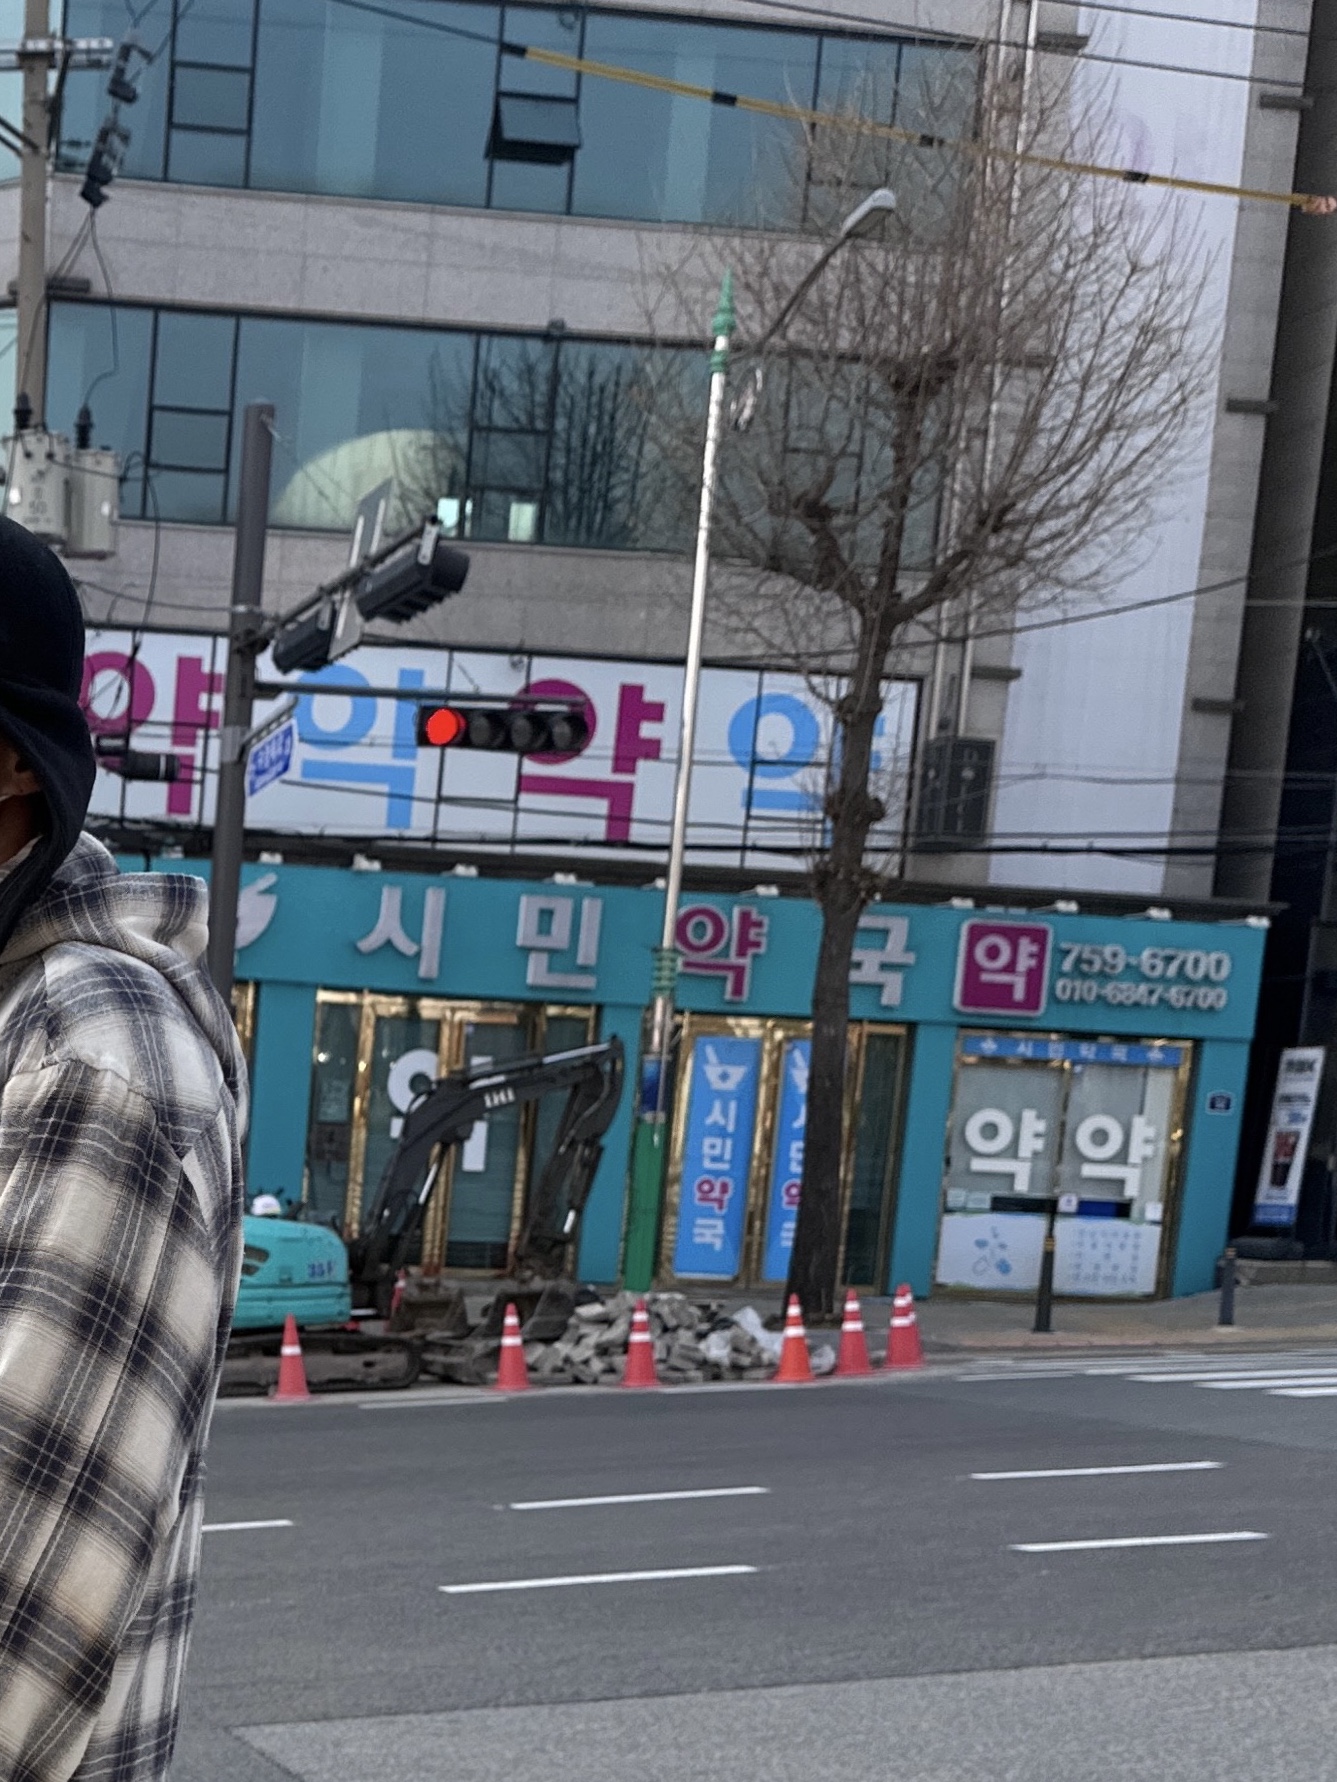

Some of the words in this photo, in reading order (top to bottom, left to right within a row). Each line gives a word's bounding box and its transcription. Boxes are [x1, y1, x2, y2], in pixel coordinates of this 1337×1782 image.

[356, 885, 916, 1006] 시민약국
[974, 934, 1040, 1002] 약
[1060, 943, 1232, 982] 759-6700
[693, 1100, 737, 1251] 시민약국
[964, 1108, 1047, 1192] 약
[1075, 1113, 1157, 1198] 약
